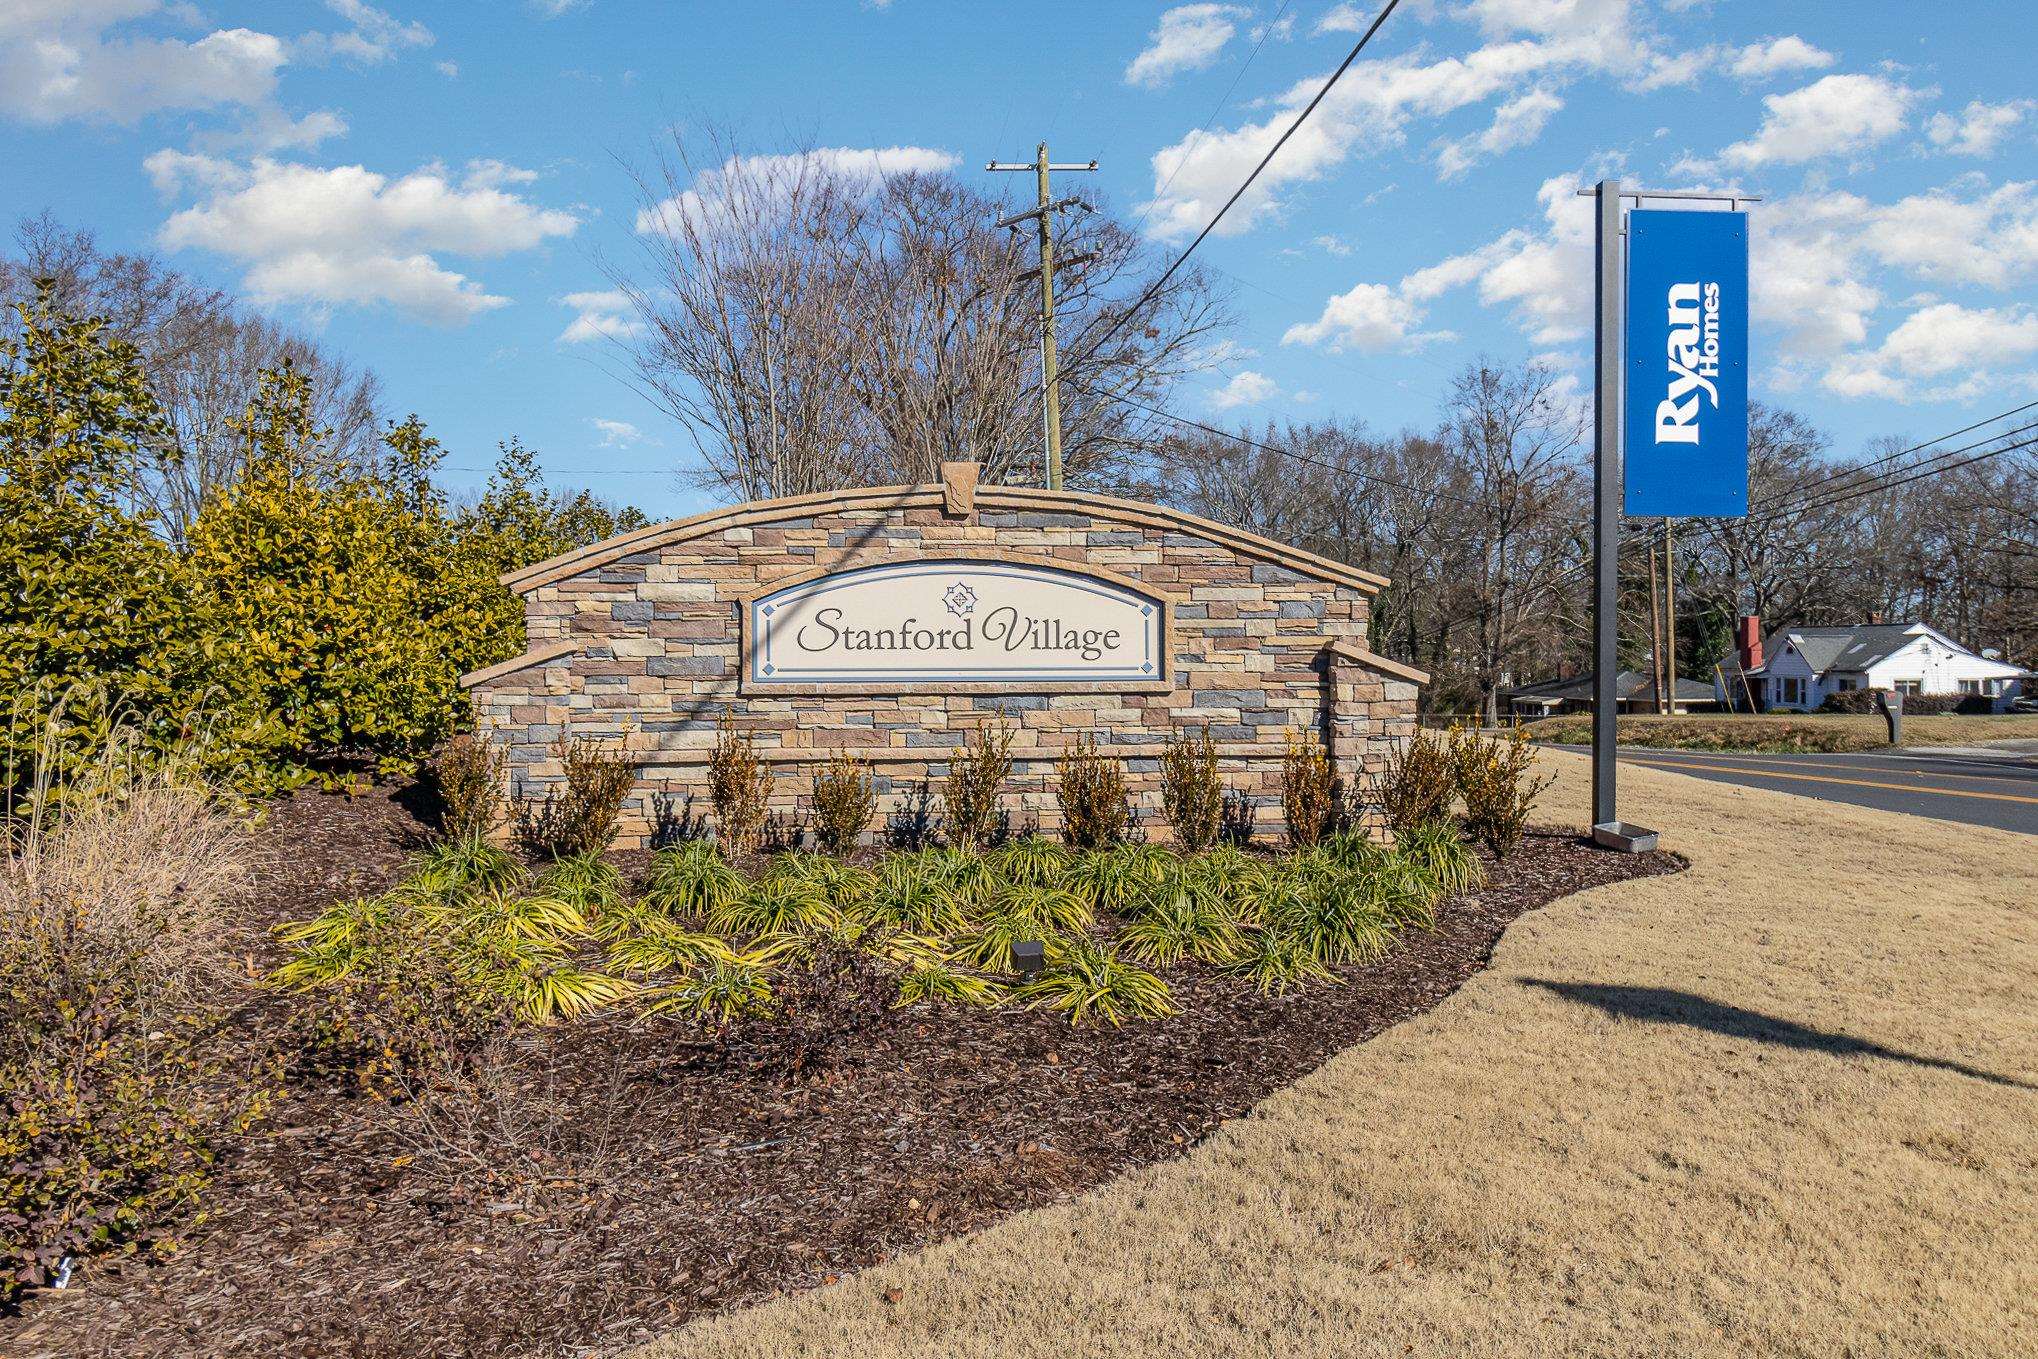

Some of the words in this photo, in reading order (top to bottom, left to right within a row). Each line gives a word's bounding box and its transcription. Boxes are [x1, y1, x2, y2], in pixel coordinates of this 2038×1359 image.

[1655, 281, 1719, 445] Ryan
[1699, 281, 1720, 377] Homes
[796, 608, 975, 652] Stanford
[980, 606, 1121, 661] Village
